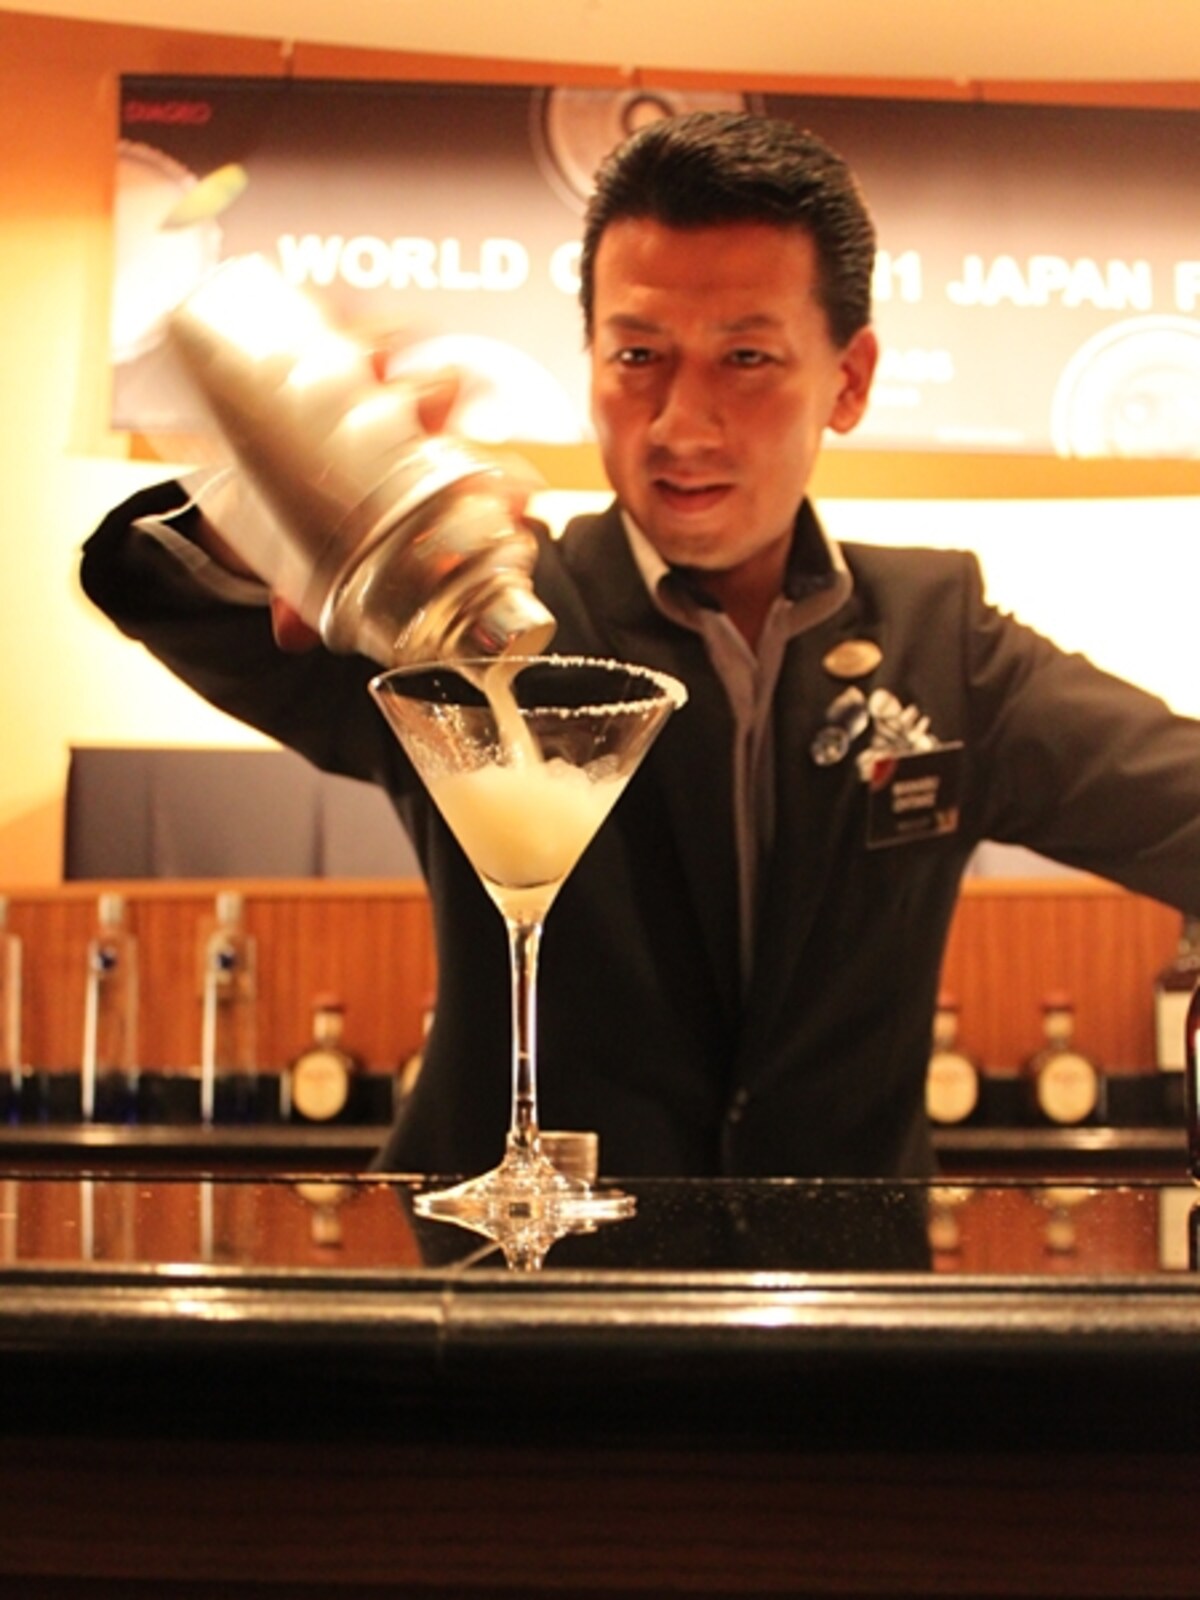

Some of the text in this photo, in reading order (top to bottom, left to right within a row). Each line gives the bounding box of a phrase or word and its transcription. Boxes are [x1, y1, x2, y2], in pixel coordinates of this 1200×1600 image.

[278, 235, 528, 290] WORLD
[948, 254, 1152, 309] JAPAN
[1176, 262, 1200, 310] F
